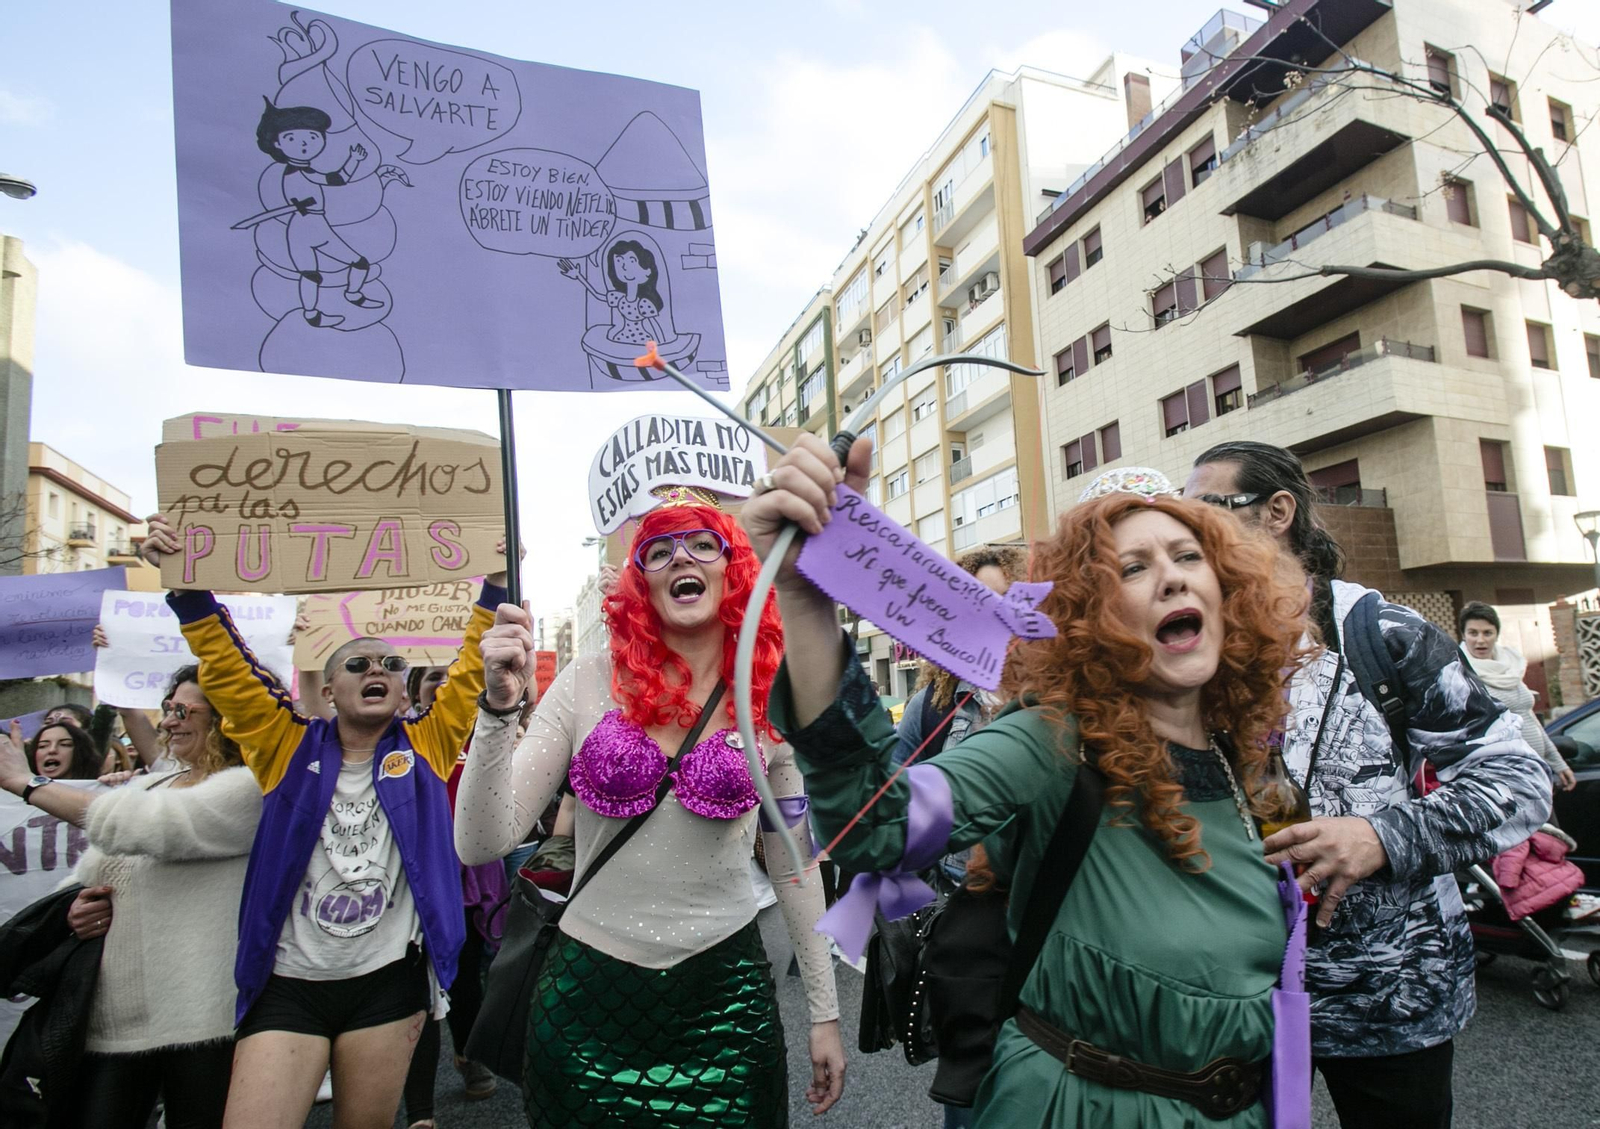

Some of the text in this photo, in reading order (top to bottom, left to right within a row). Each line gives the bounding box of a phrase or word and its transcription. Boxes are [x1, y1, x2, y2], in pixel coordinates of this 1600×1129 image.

[371, 49, 500, 100] VENGO A
[364, 86, 499, 131] SALVARTE
[464, 178, 510, 202] ESTOY
[487, 158, 542, 183] ESTOY
[469, 202, 523, 232] ÁBRETE
[530, 211, 551, 236] UN
[189, 440, 491, 498] derechos
[599, 416, 751, 478] CALLADITA NO
[596, 446, 757, 527] ESTÁS MÁS GUAPA
[166, 490, 300, 533] pa las
[182, 516, 470, 584] PUTAS
[405, 603, 425, 613] ME
[428, 603, 471, 613] GUSTA
[878, 568, 907, 592] que
[906, 583, 958, 621] fuera
[365, 619, 425, 635] CUANDO
